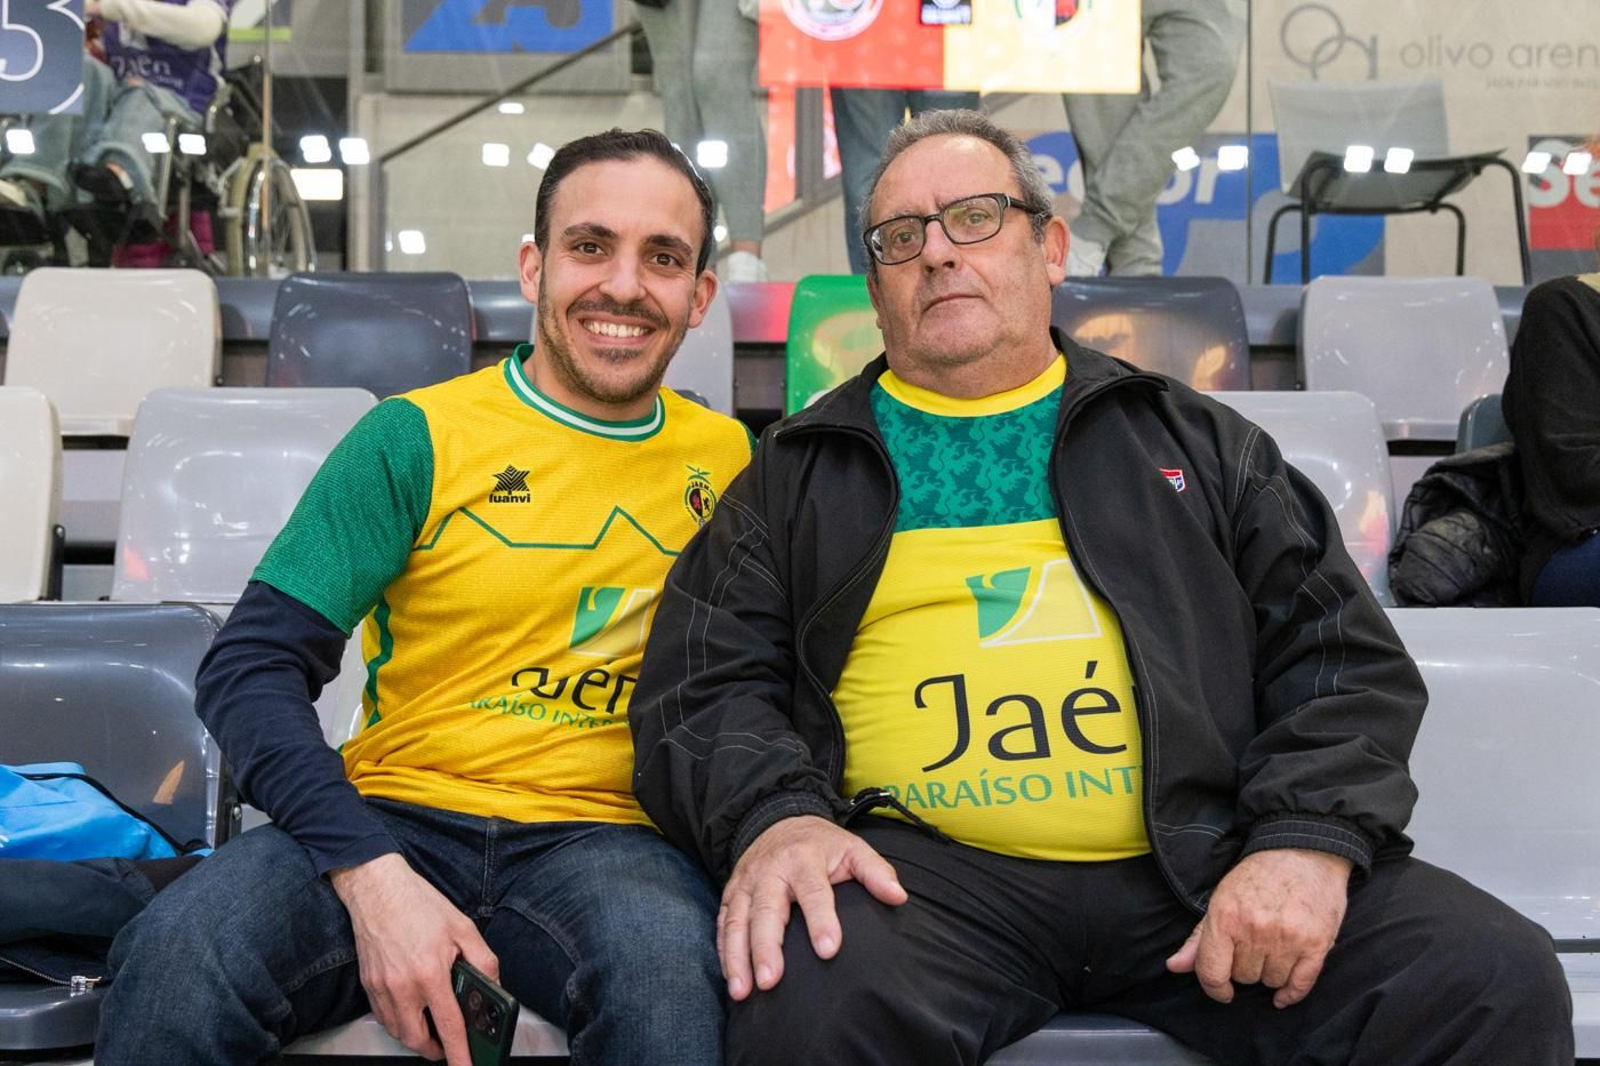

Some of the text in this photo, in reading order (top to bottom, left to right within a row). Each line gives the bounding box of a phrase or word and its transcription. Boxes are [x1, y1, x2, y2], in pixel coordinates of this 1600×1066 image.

[1400, 34, 1494, 69] olivo
[914, 660, 1139, 773] Jaé
[885, 768, 1053, 810] PARAÍSO
